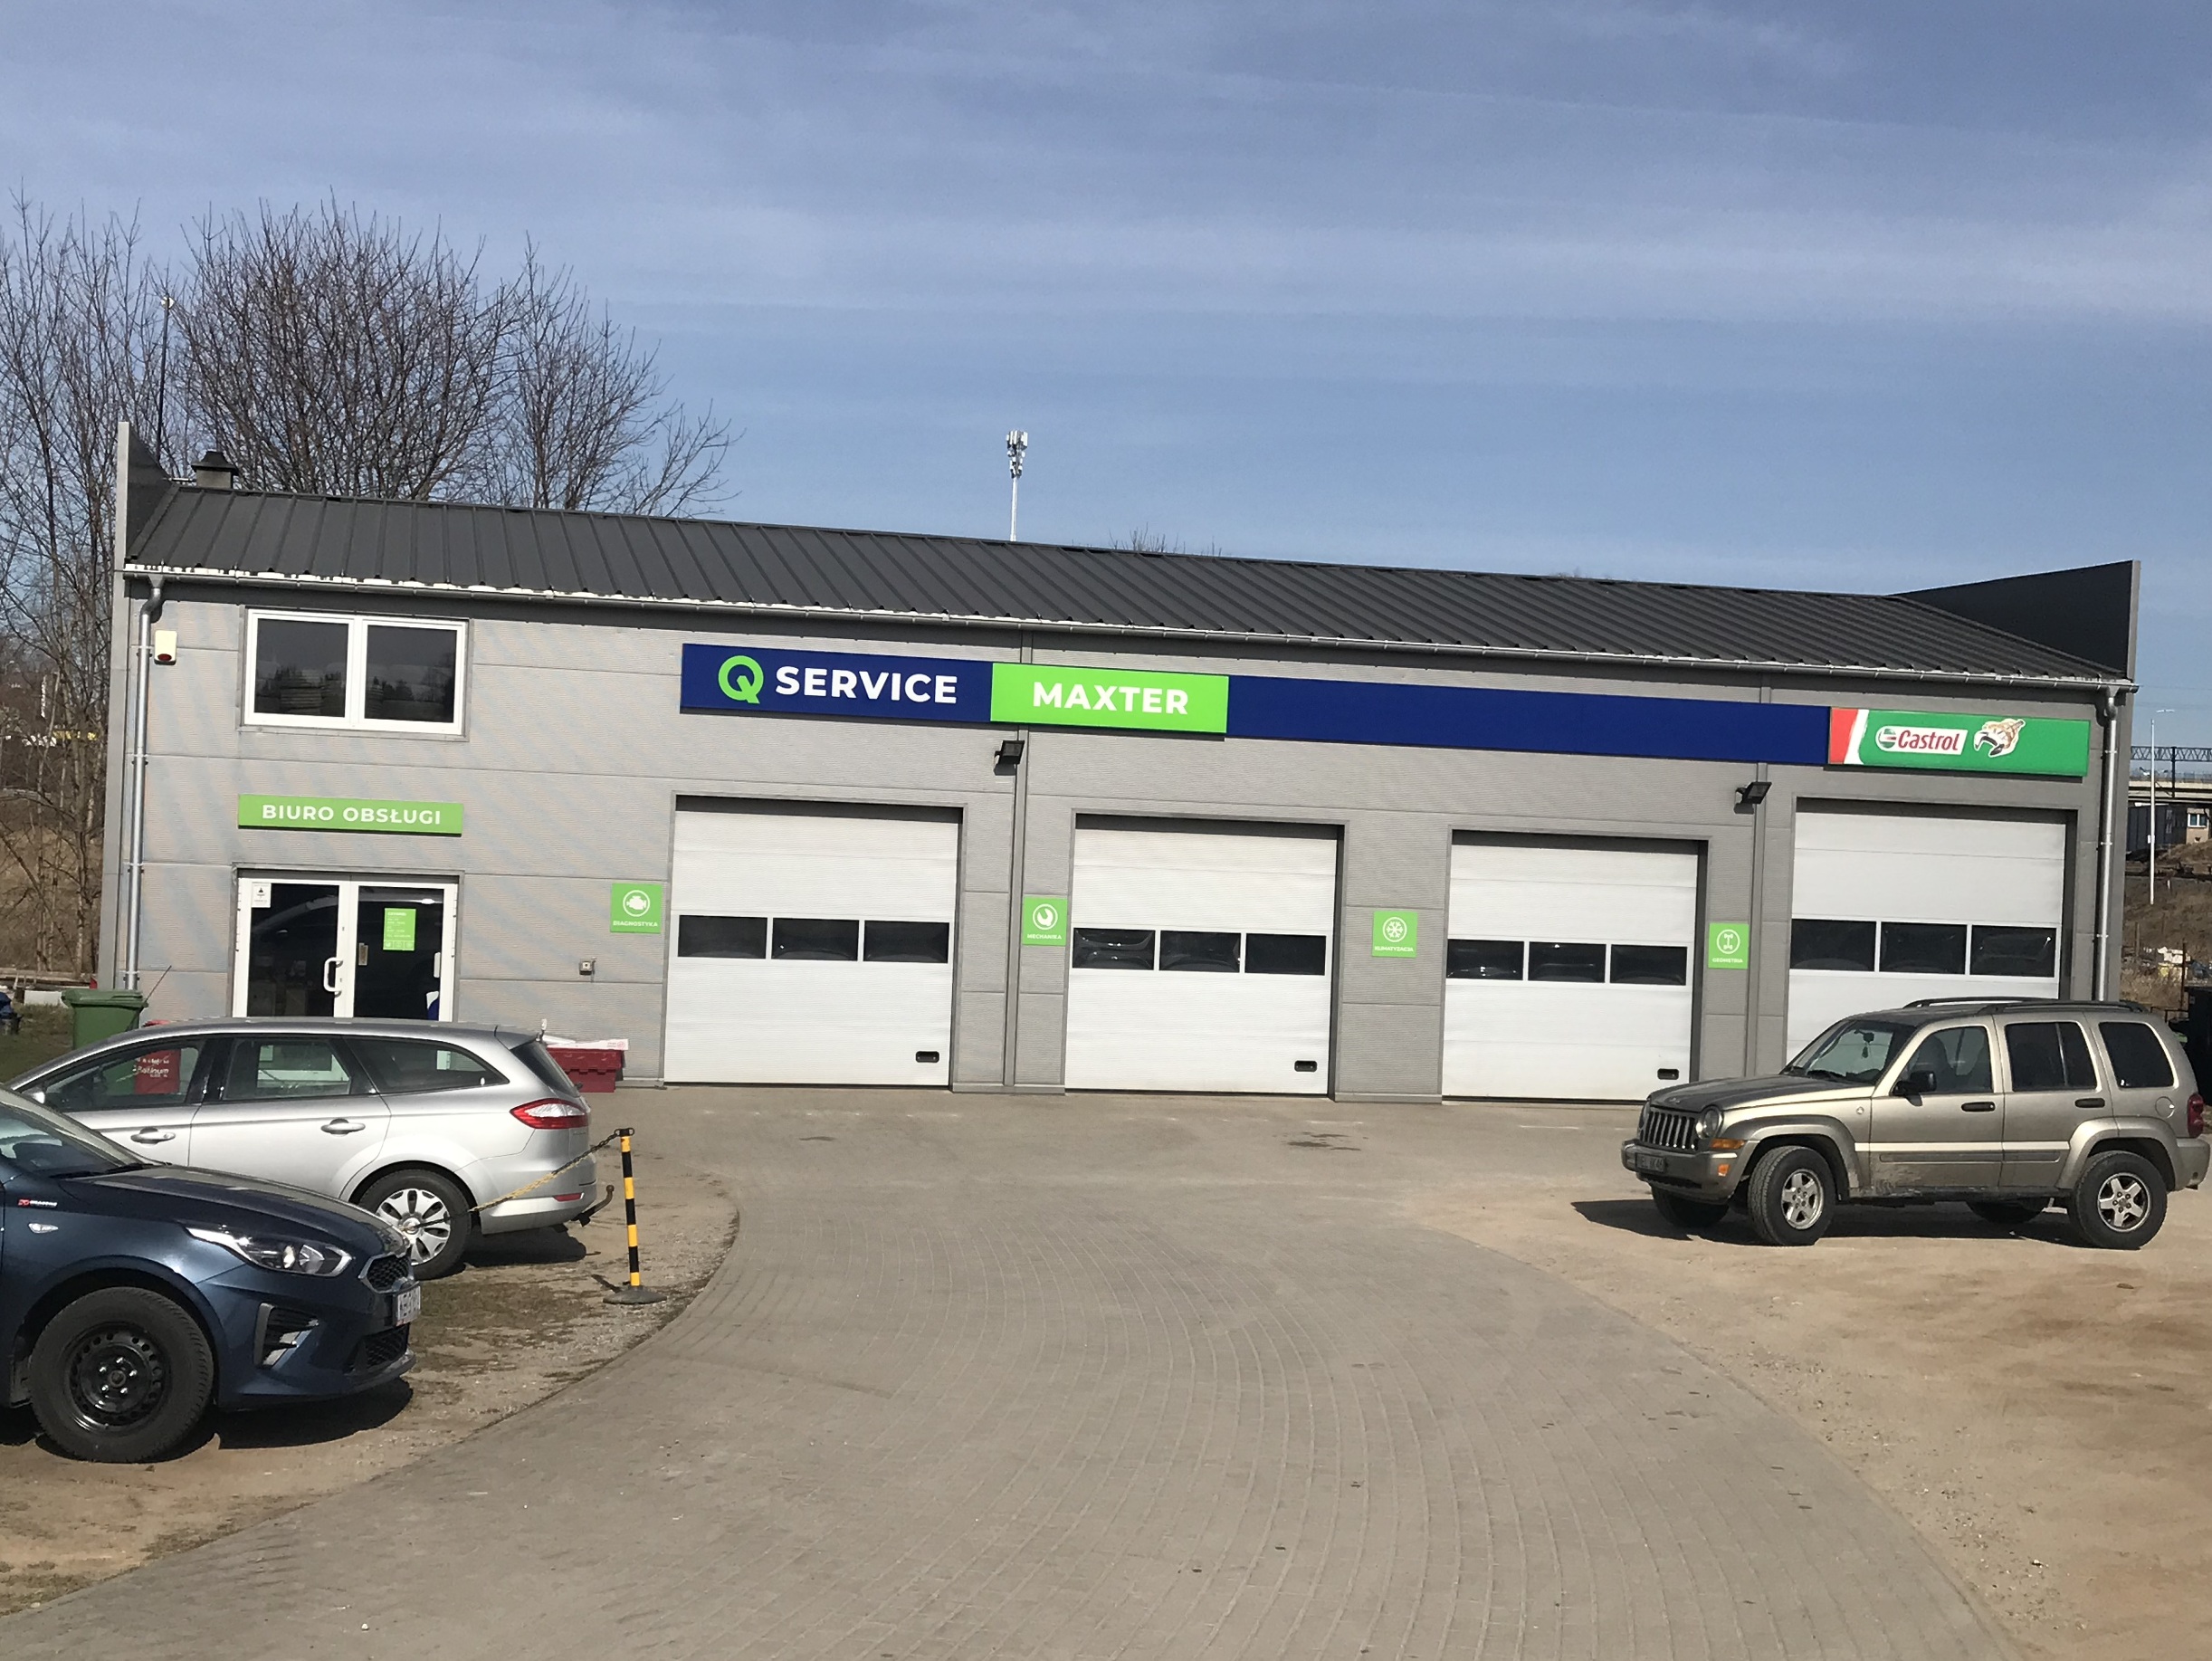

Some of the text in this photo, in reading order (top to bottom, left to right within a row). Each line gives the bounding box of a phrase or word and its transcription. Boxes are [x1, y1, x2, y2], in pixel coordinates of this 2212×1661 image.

[718, 655, 958, 704] Q SERVICE
[1033, 682, 1189, 715] MAXTER
[1898, 730, 1959, 750] Castrol
[262, 804, 441, 825] BIURO OBSŁUGI
